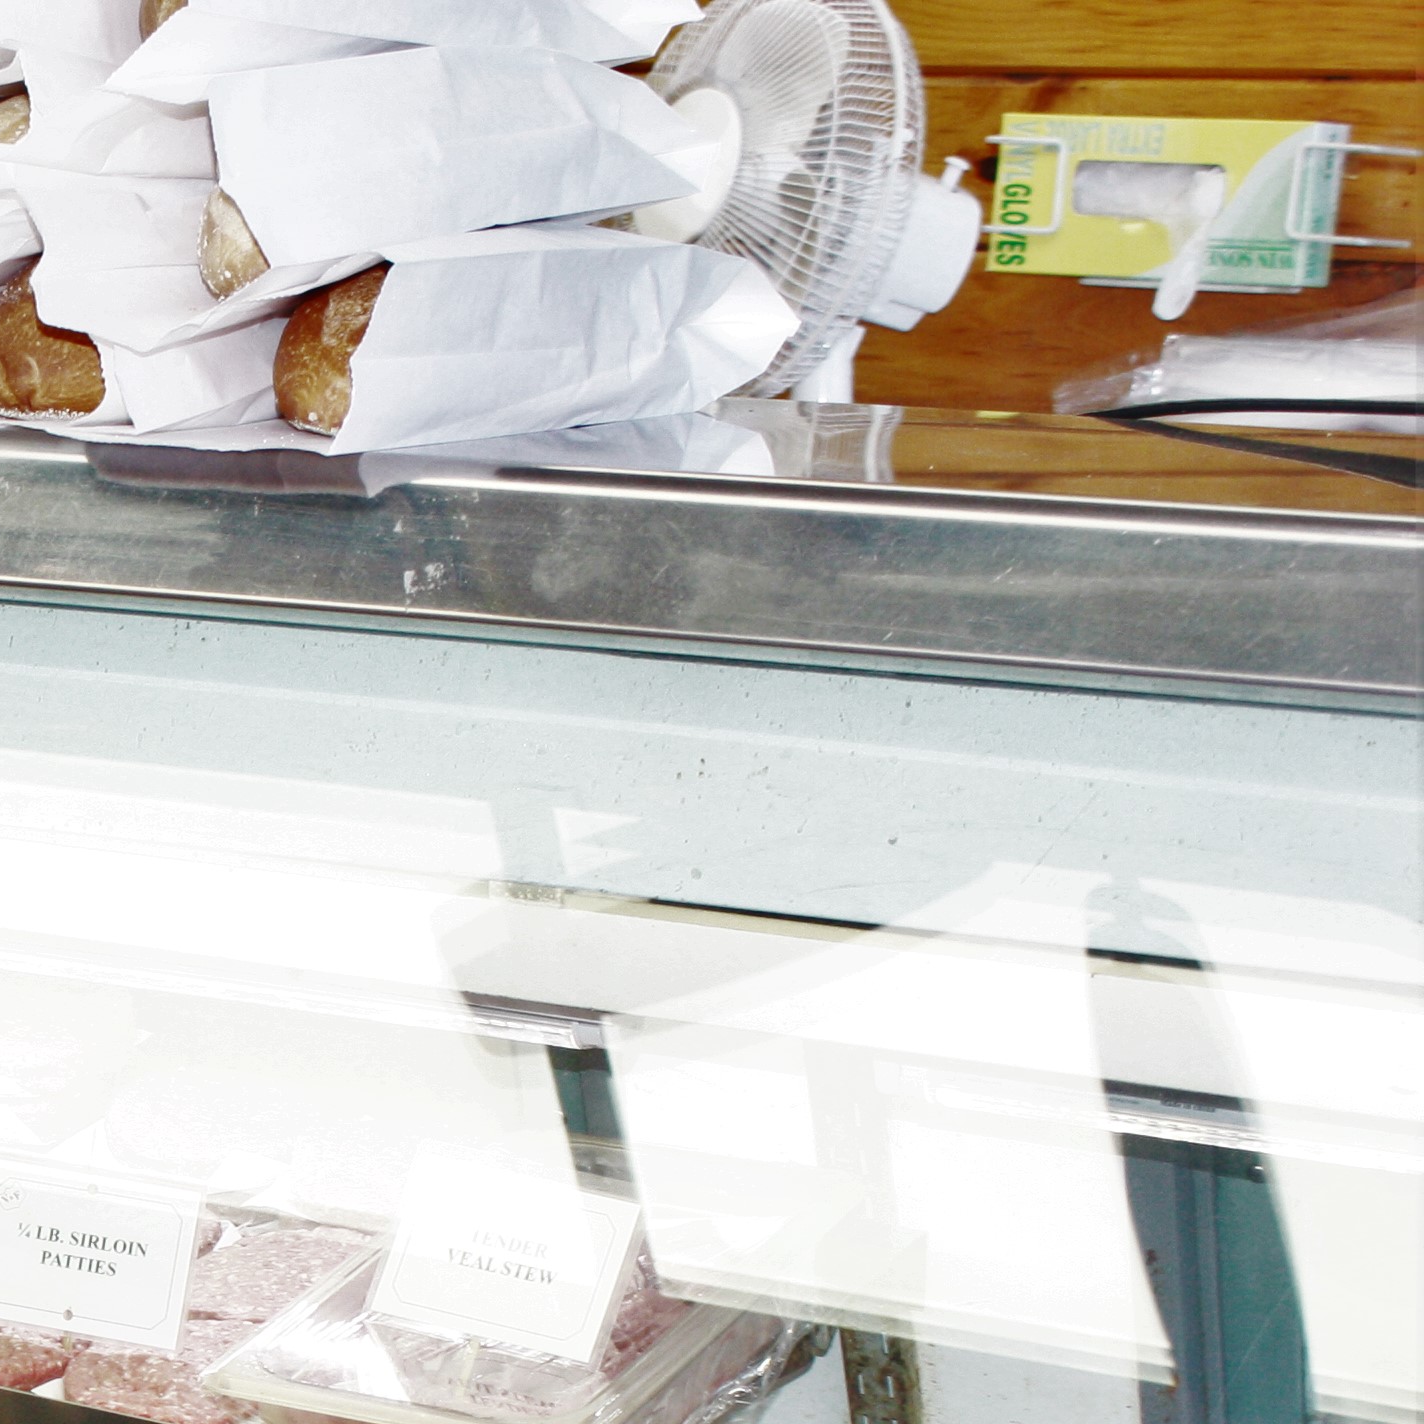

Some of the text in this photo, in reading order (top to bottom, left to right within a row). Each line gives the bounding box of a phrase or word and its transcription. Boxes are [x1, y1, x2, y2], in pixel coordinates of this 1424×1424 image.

[35, 1225, 149, 1257] LB. SIRLOIN
[472, 1229, 548, 1259] TENDER
[40, 1250, 118, 1277] PATTIES
[448, 1248, 557, 1285] VEAL STEW
